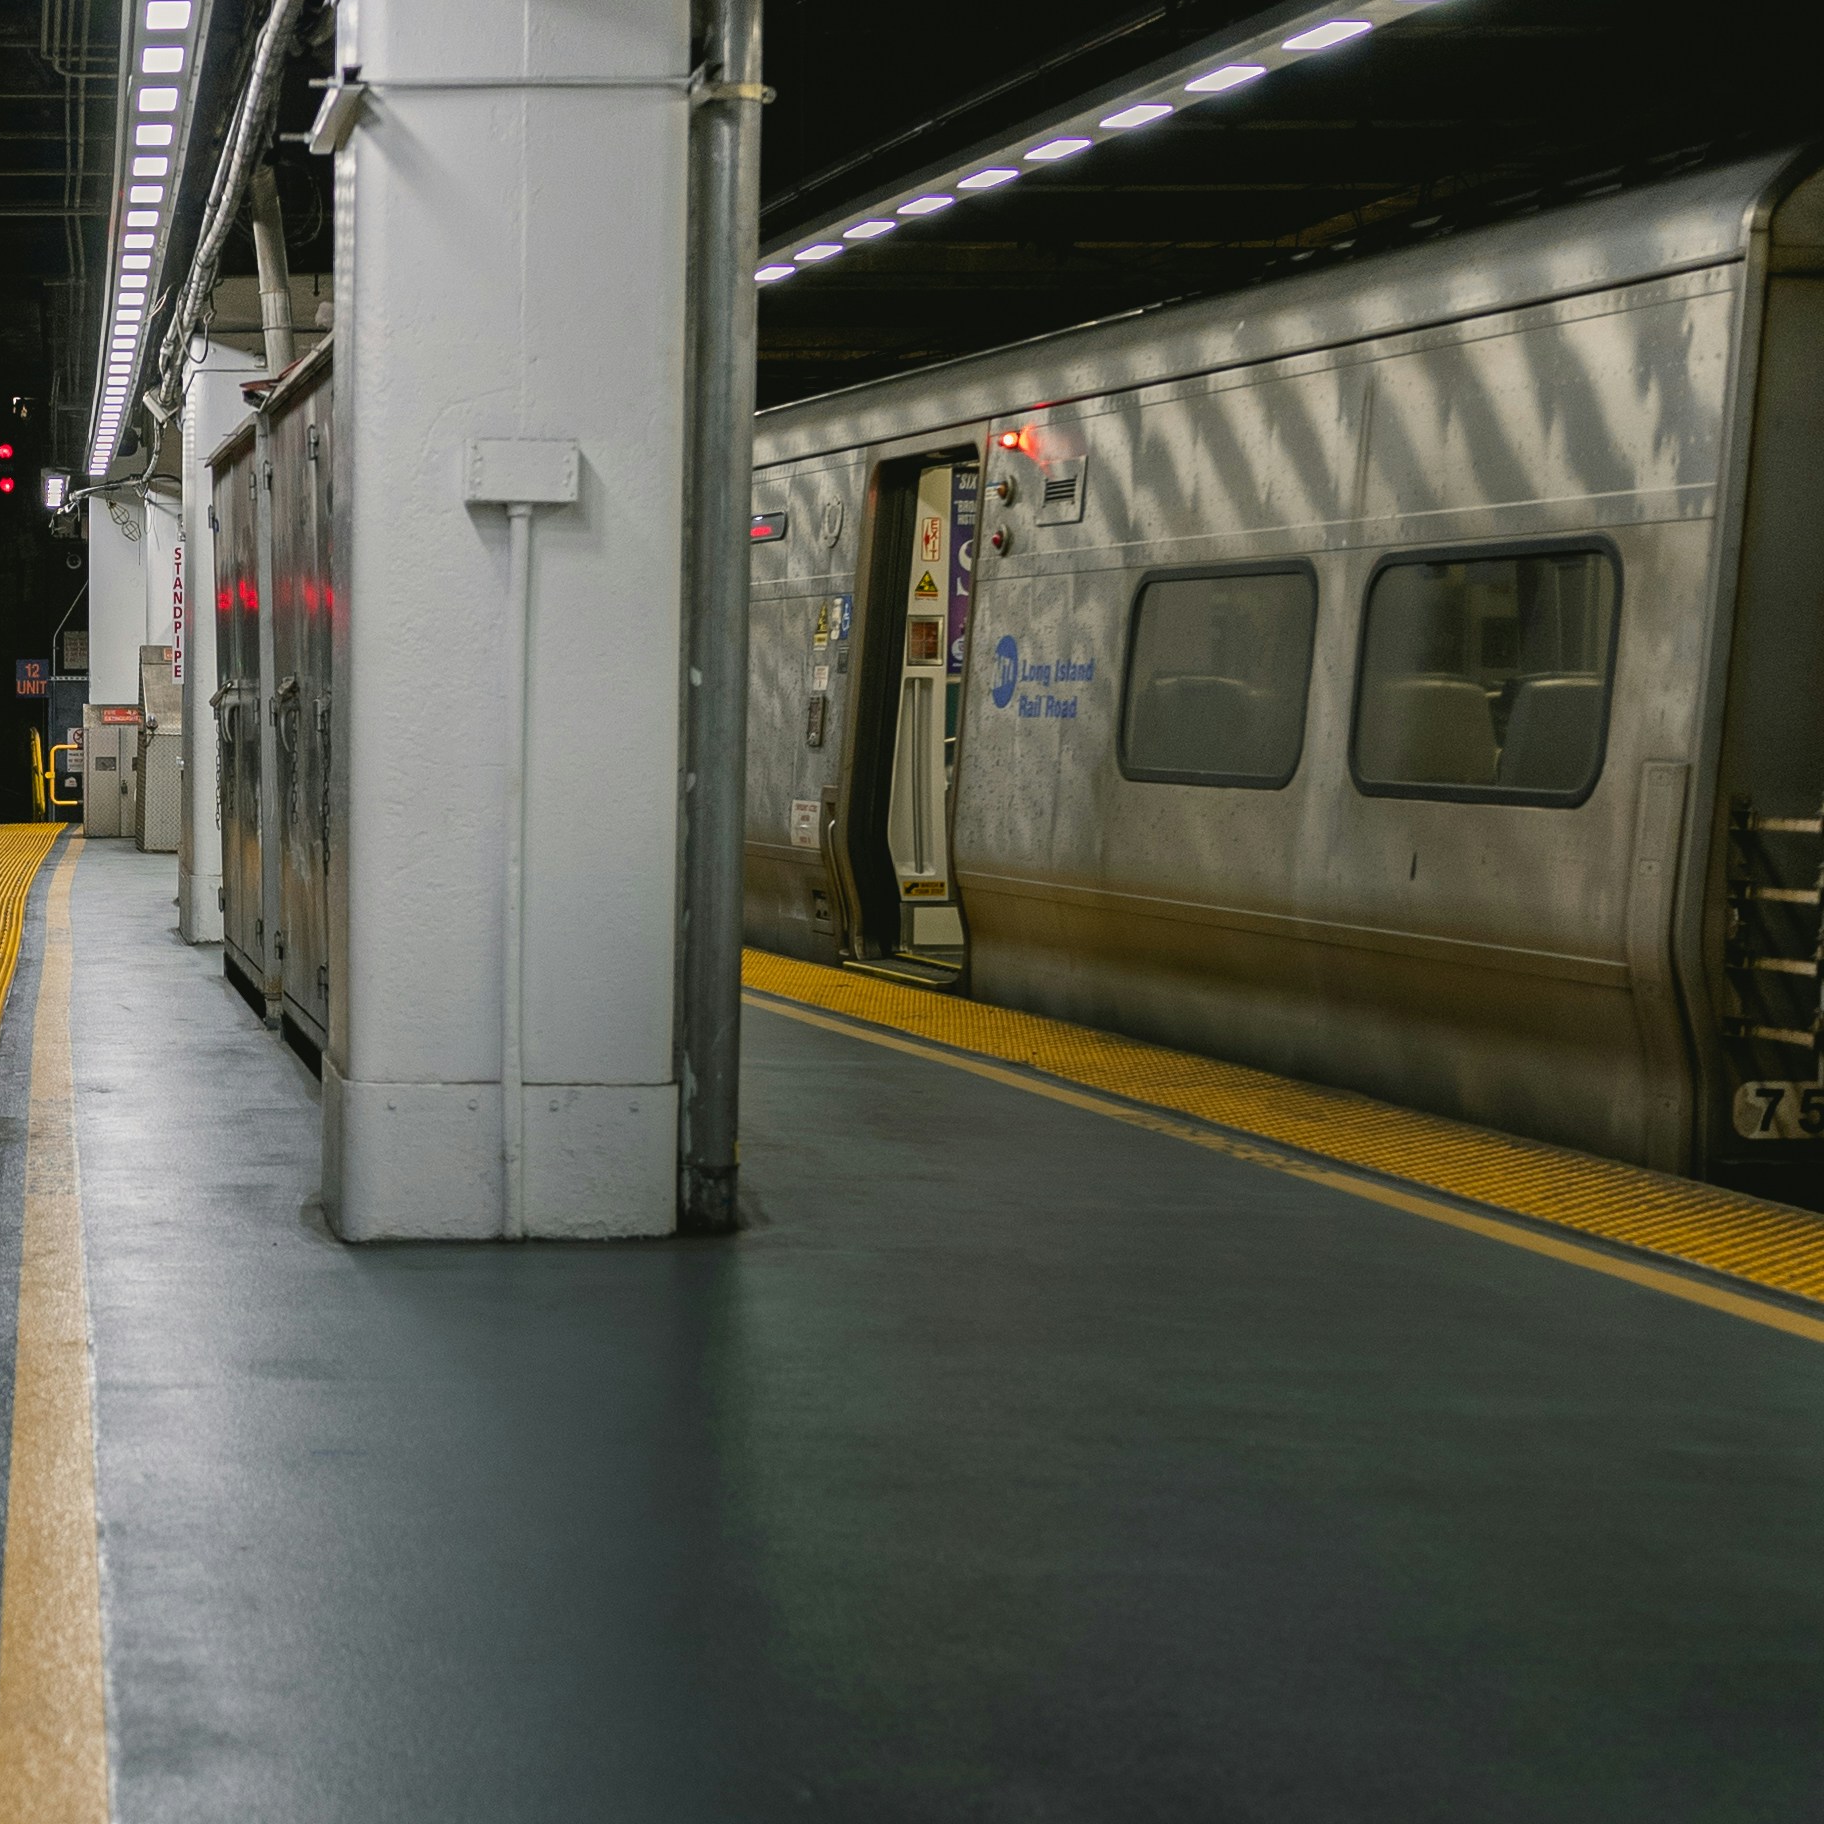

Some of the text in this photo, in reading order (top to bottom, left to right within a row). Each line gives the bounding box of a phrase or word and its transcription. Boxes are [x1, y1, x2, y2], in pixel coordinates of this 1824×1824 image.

[173, 547, 183, 678] STANDPIPE
[25, 663, 41, 678] 12
[1022, 657, 1095, 687] Long Island
[17, 680, 47, 694] UNIT
[1018, 695, 1078, 718] Rail Road
[1756, 1088, 1824, 1133] 75
